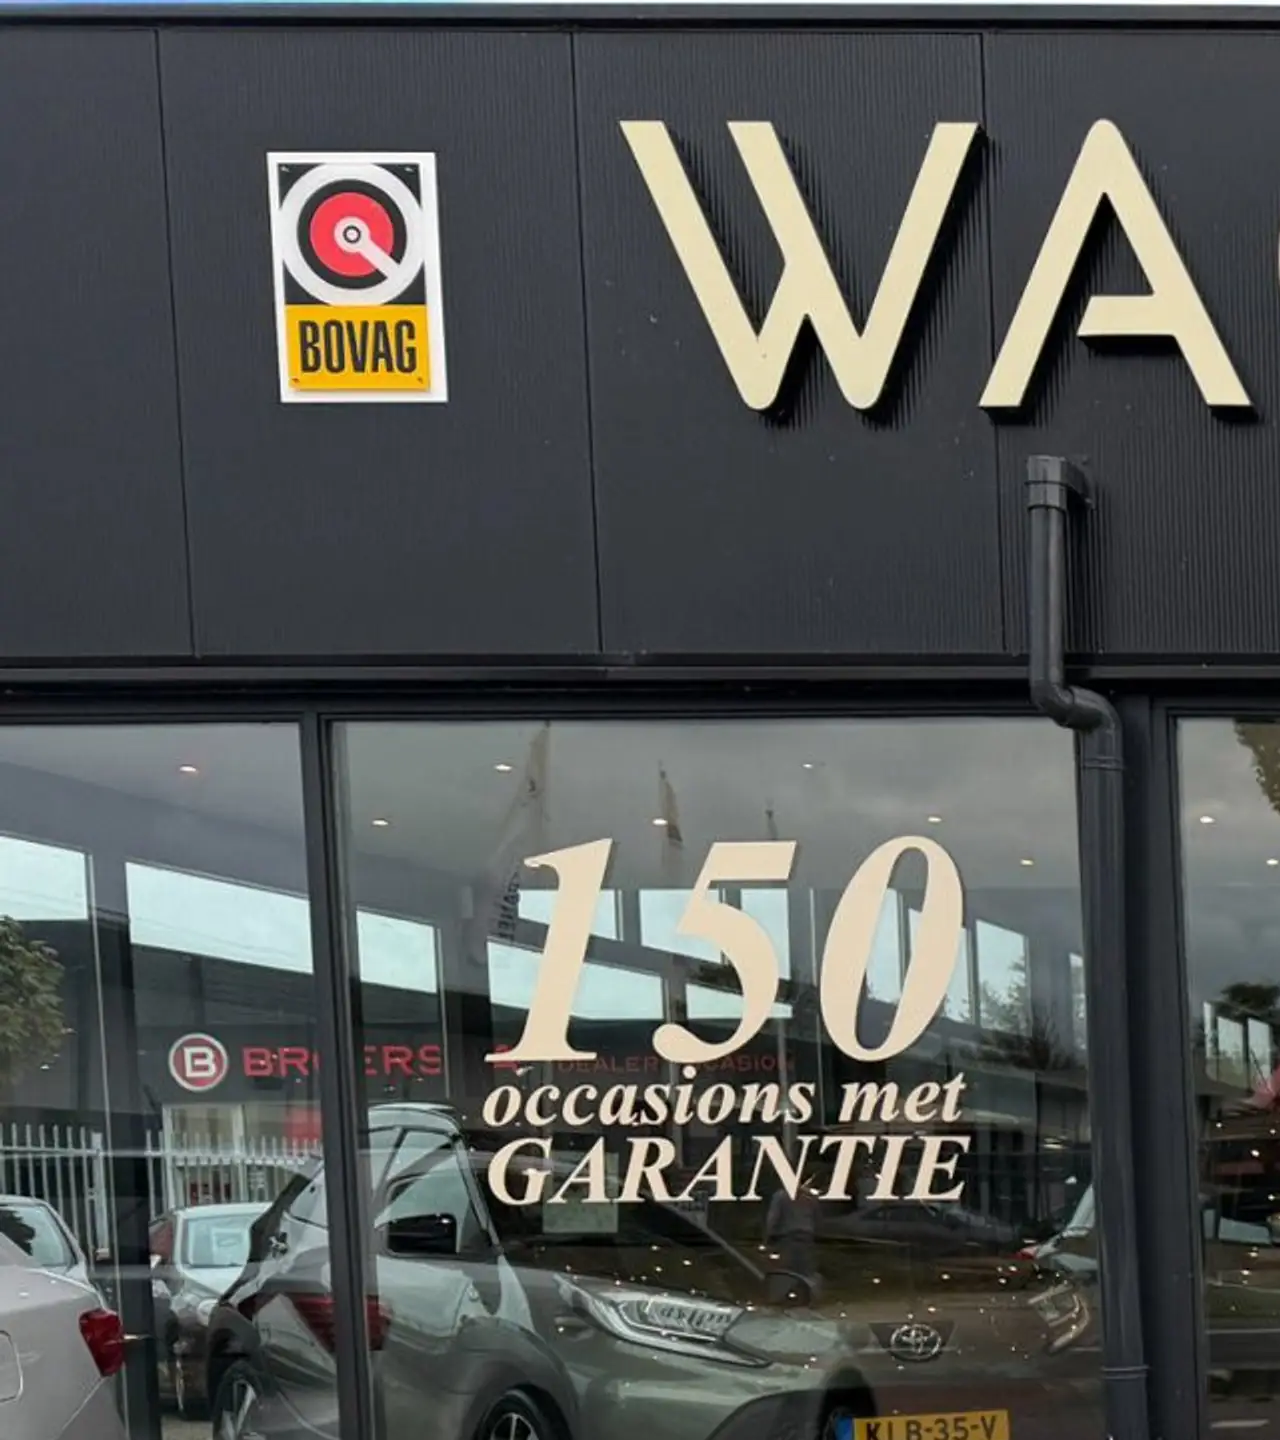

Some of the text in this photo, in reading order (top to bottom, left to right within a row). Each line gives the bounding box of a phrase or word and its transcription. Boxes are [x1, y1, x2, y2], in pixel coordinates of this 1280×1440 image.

[298, 319, 417, 373] BOVAG
[484, 835, 964, 1062] 150
[482, 1065, 967, 1128] occasions met
[487, 1135, 972, 1206] GARANTIE
